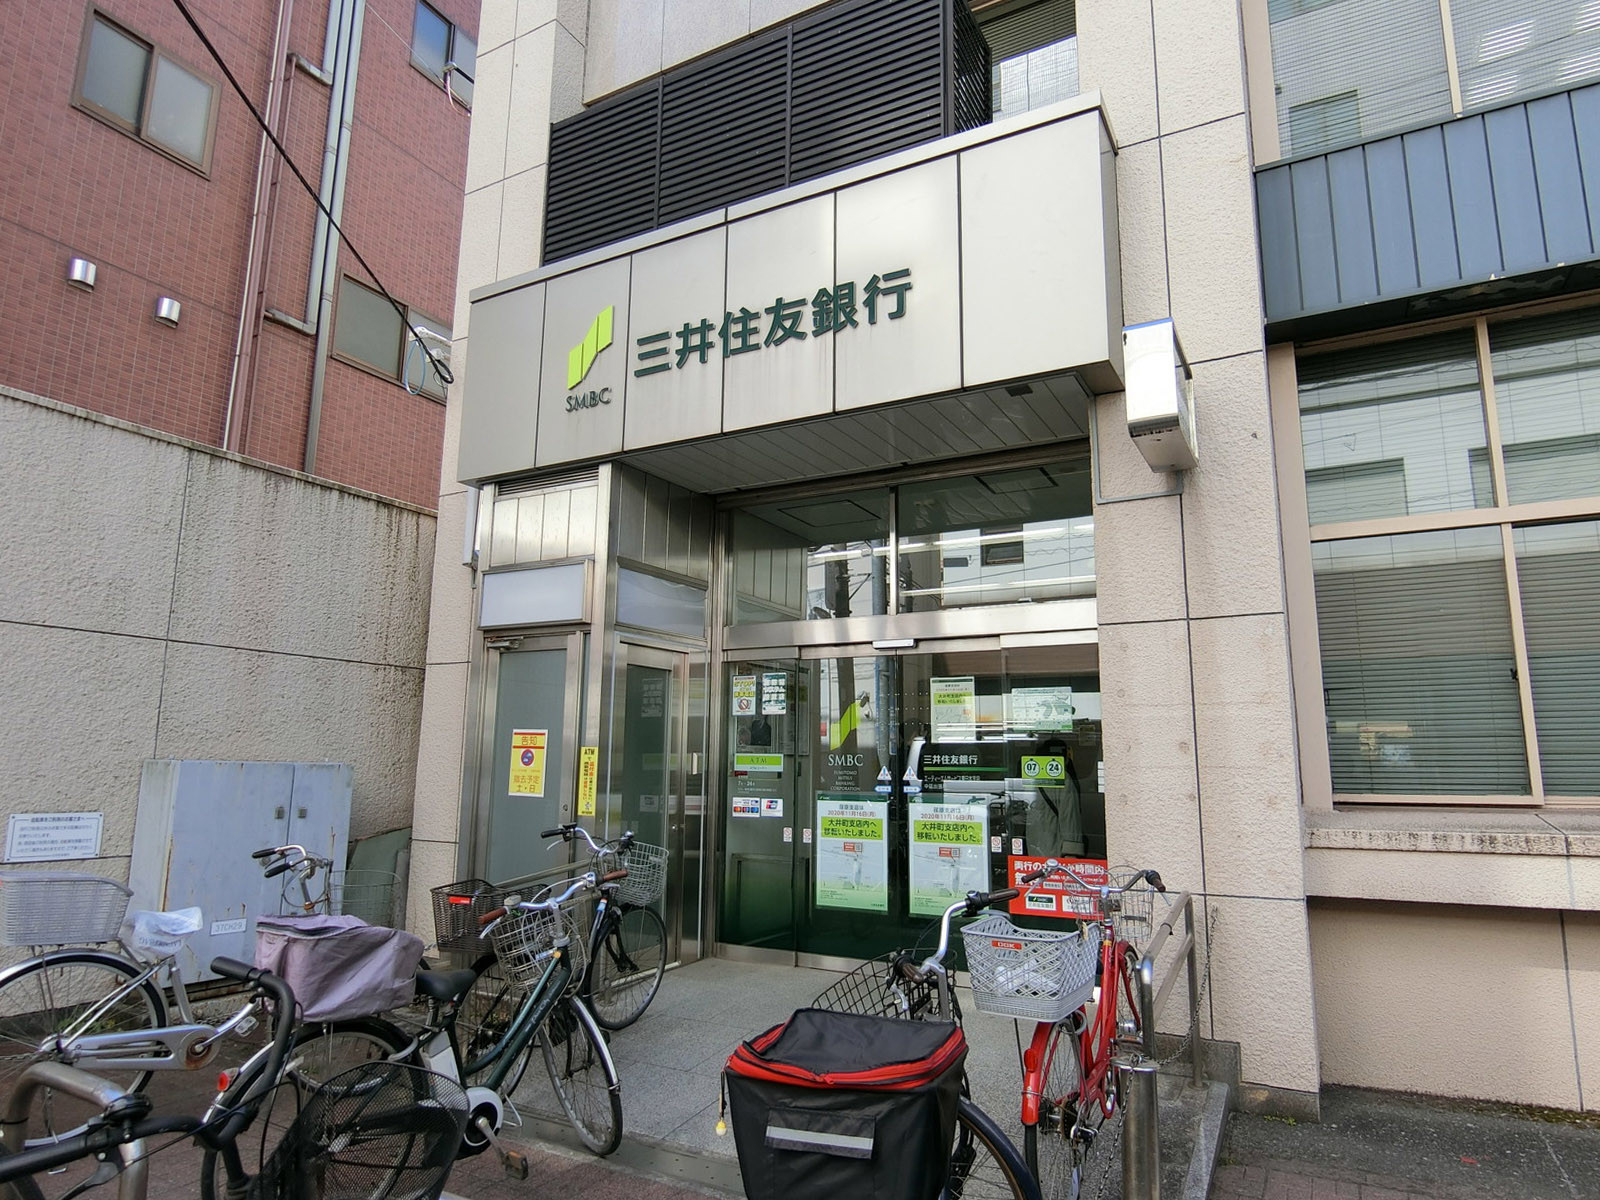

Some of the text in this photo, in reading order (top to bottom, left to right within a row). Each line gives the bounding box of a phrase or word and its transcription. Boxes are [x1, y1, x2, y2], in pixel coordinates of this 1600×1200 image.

[634, 268, 913, 378] 三井住友銀行
[565, 387, 612, 413] SMBC
[521, 736, 538, 746] 告知
[828, 753, 864, 767] SMBC
[923, 754, 978, 766] 三井住友銀行
[1026, 763, 1060, 772] 07 24
[828, 819, 877, 829] 大井町支店内へ
[921, 822, 975, 833] 大井町支店内へ
[823, 827, 881, 838] 移転いたしました。
[917, 831, 982, 843] 移転いたしました。
